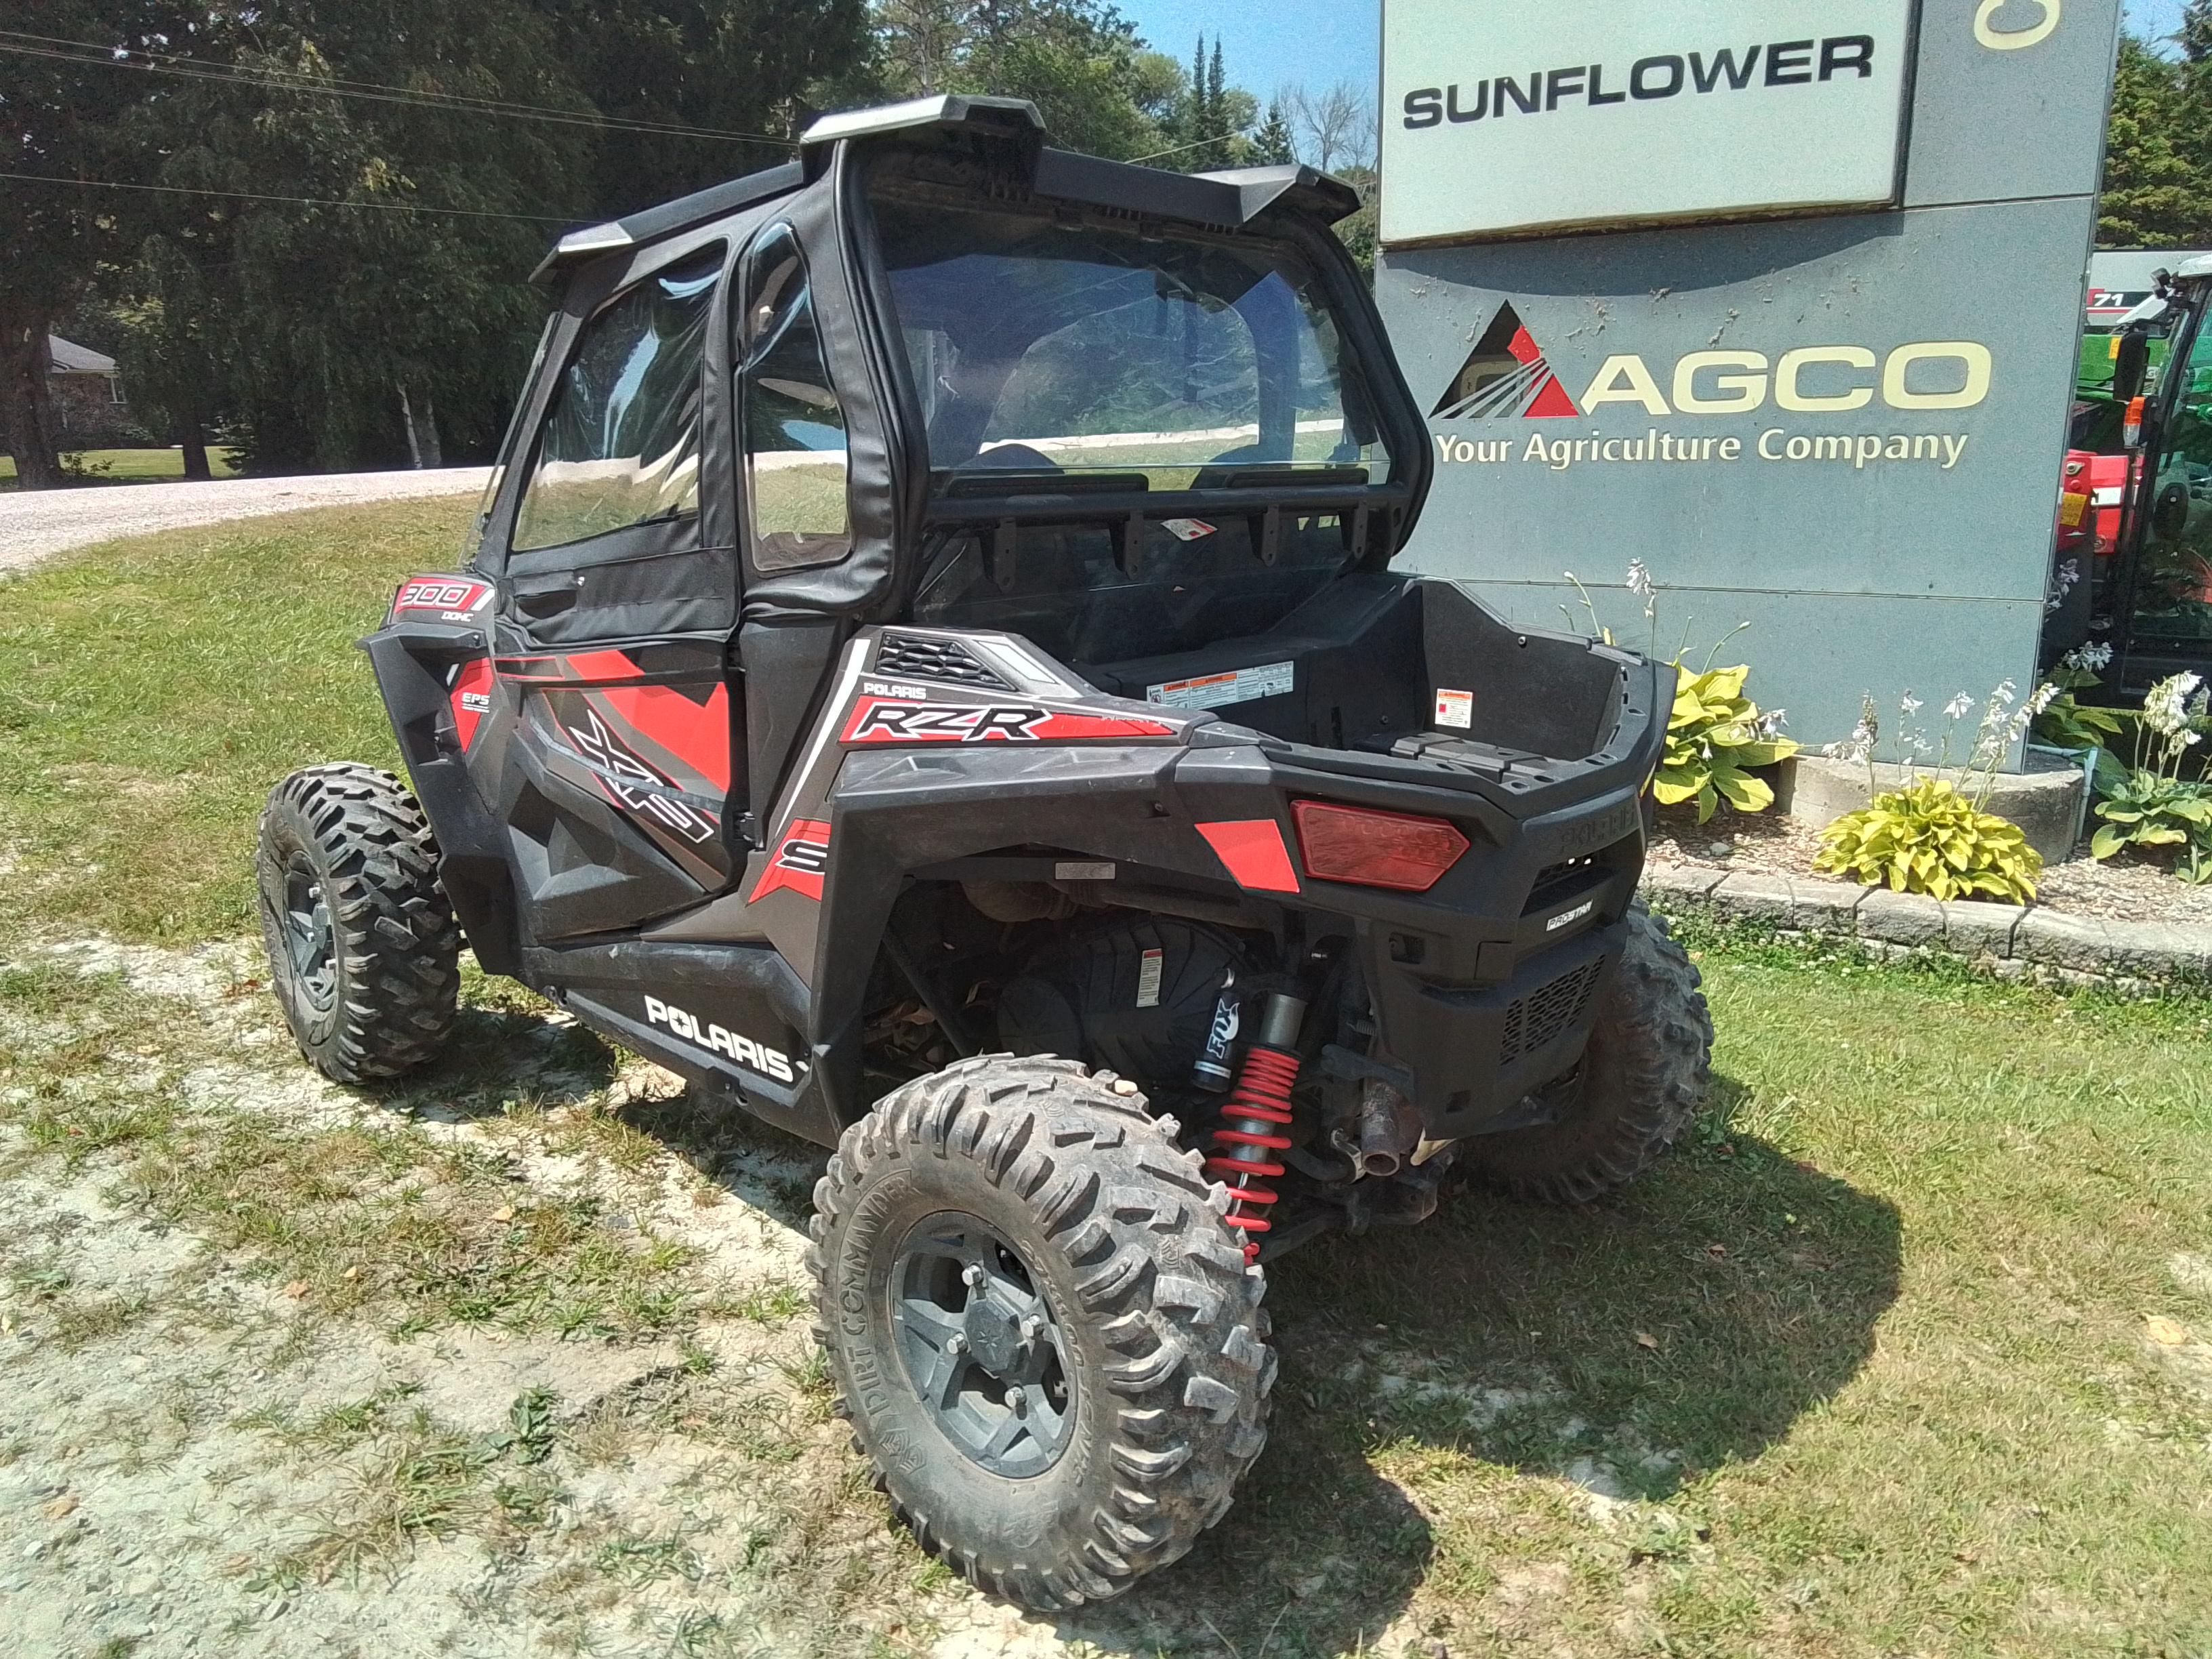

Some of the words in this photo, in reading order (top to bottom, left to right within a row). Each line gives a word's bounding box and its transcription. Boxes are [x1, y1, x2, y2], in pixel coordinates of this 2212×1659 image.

[1404, 35, 1875, 129] SUNFLOWER
[1580, 340, 1992, 416] AGCO
[1435, 434, 1513, 462] Your
[1522, 428, 1741, 470] Agriculture
[1758, 428, 1969, 469] Company
[441, 611, 474, 622] DOHC
[462, 692, 490, 705] EPS
[863, 682, 927, 700] POLARIS
[851, 702, 1053, 742] RZR
[1547, 899, 1593, 931] PROSTAR
[644, 995, 794, 1083] POLARIS
[1206, 998, 1236, 1059] FOX
[839, 1176, 924, 1336] COMMANDER
[847, 1345, 890, 1416] DIRT
